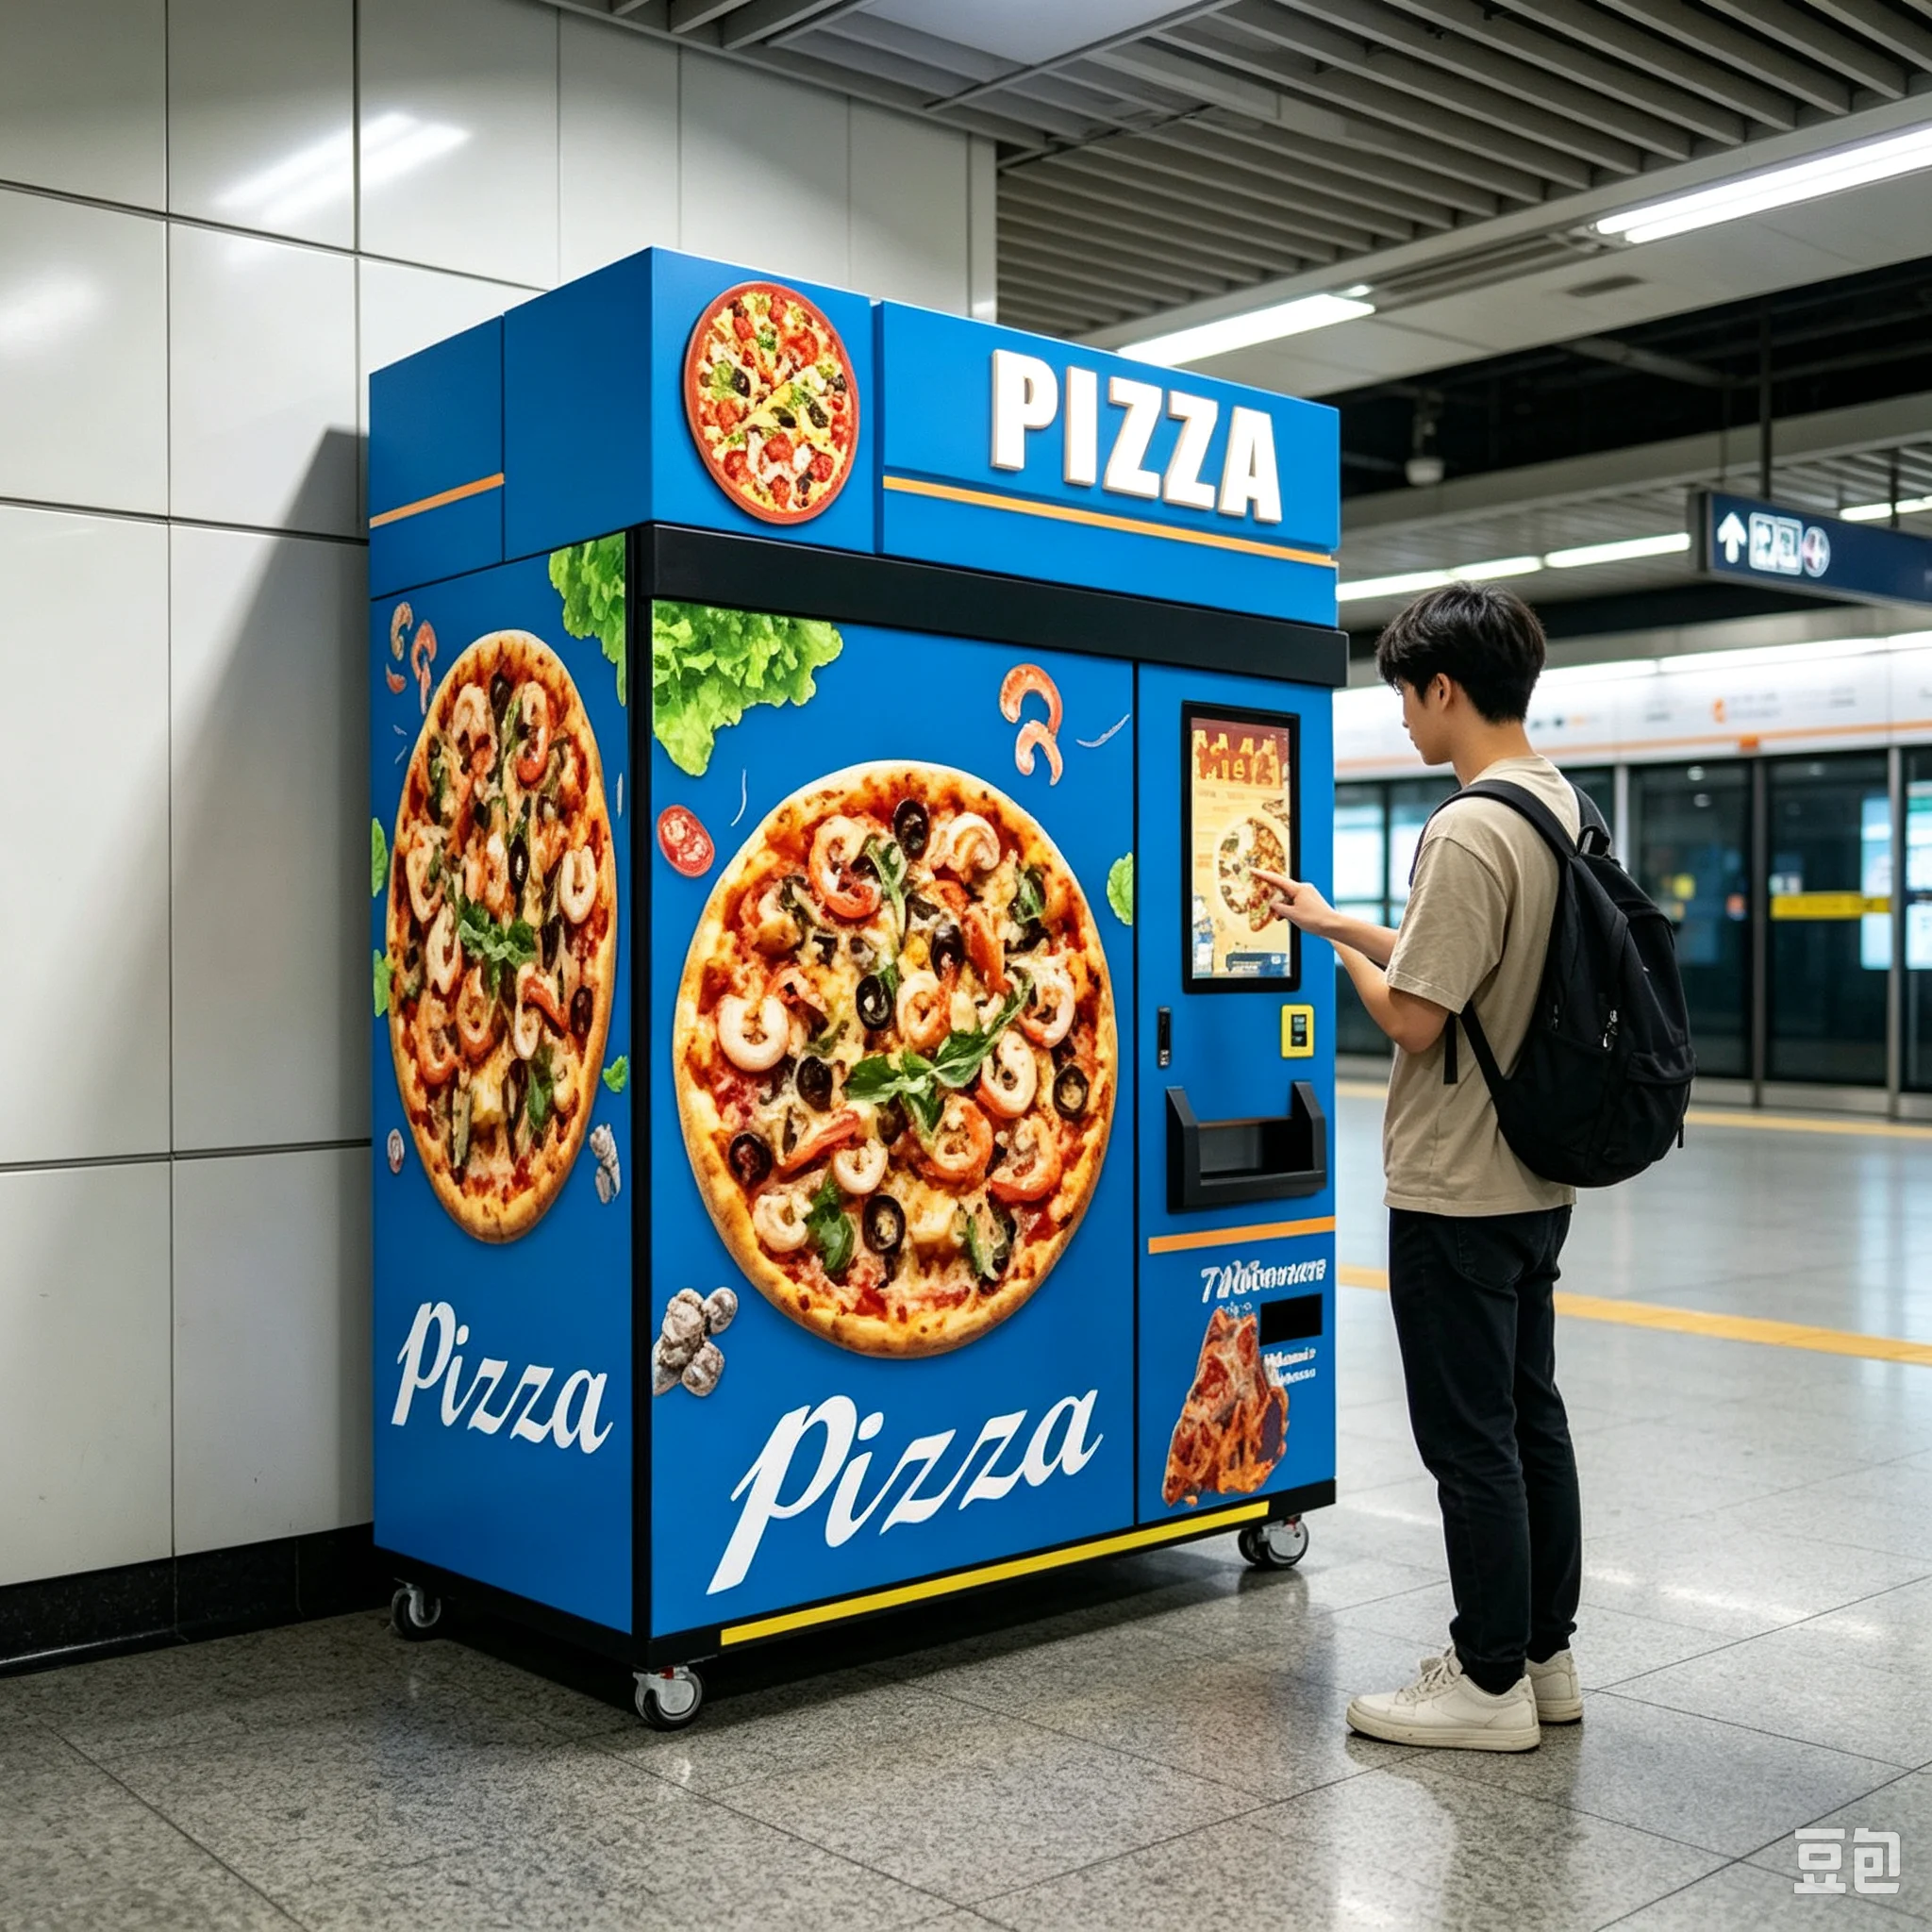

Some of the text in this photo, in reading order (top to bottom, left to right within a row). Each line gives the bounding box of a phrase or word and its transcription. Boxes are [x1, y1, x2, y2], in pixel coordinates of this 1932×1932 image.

[991, 349, 1282, 524] PIZZA
[391, 1301, 613, 1454] Pizza
[706, 1390, 1104, 1594] Pizza
